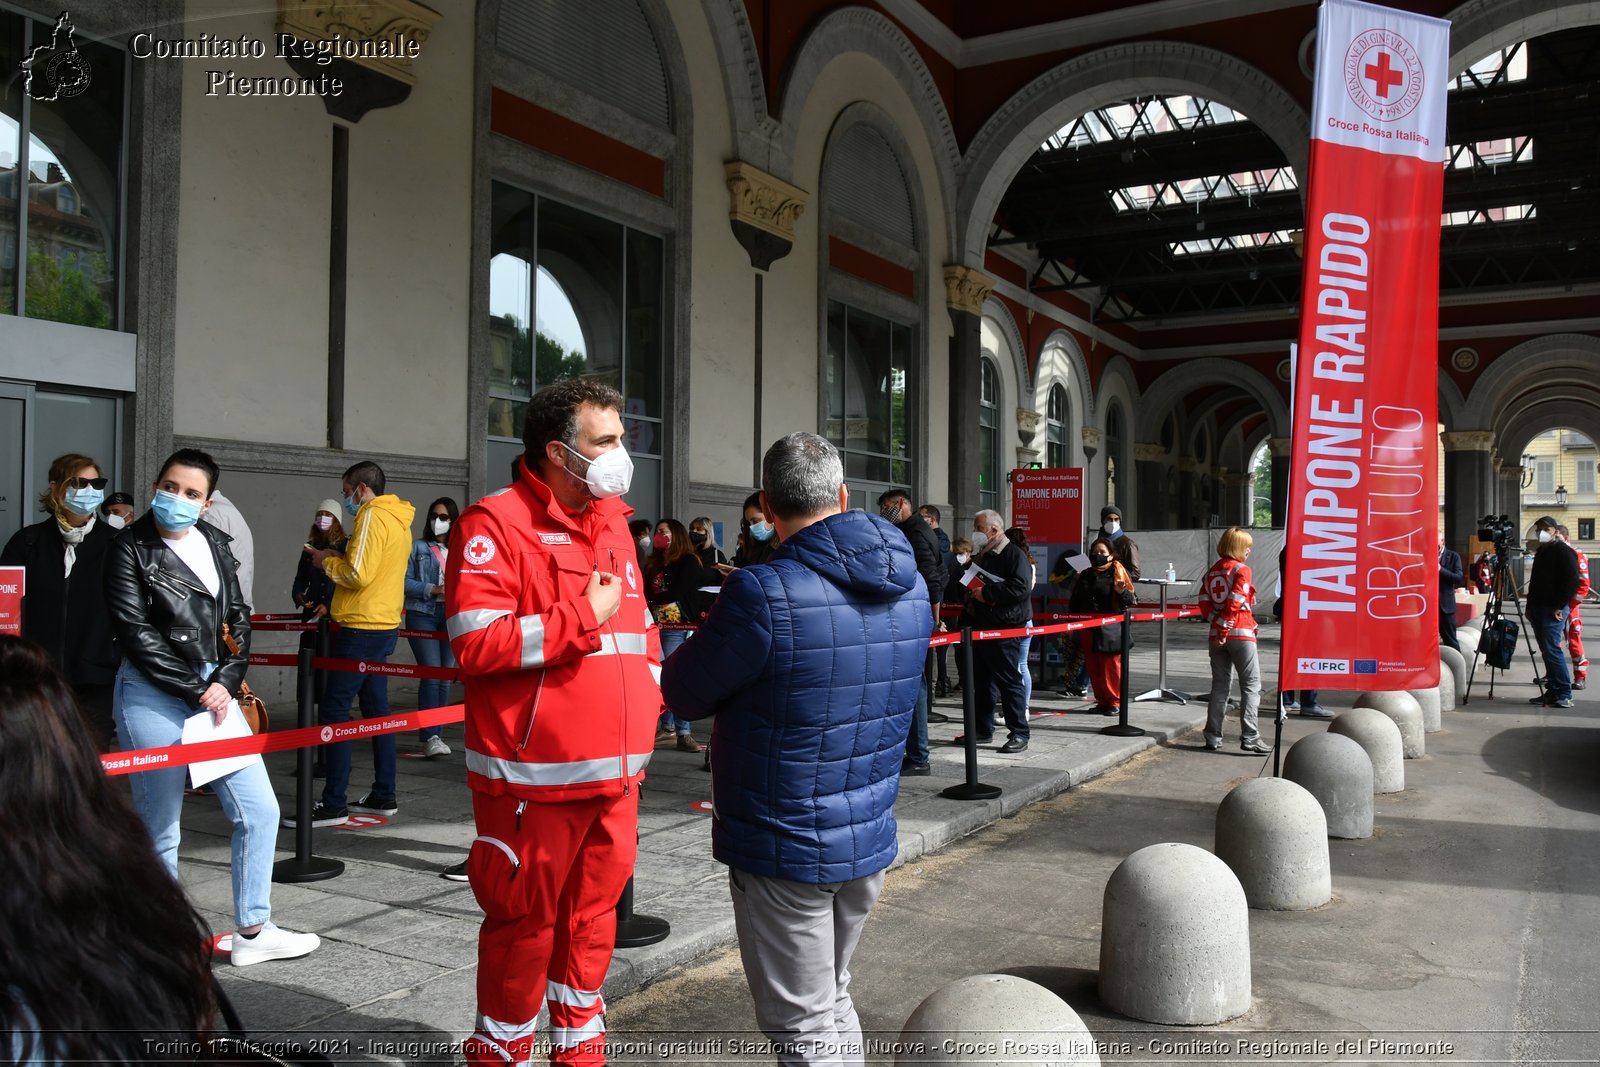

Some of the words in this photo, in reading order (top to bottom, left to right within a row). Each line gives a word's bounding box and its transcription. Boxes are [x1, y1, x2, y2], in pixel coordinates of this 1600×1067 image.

[1358, 37, 1370, 50] DI
[1370, 32, 1408, 56] GINEVRA
[1407, 56, 1417, 67] 22
[1348, 46, 1376, 113] CONVENZIONE
[1404, 69, 1422, 108] AGOSTO
[1386, 101, 1405, 117] 1864
[1328, 117, 1359, 131] Croce
[1362, 123, 1392, 139] Rossa
[1396, 129, 1430, 146] Italiana
[1313, 212, 1370, 383] RAPIDO
[1016, 488, 1050, 498] TAMPONE
[1052, 488, 1079, 498] RAPIDO
[1299, 394, 1363, 619] TAMPONE
[1367, 405, 1427, 619] GRATUITO
[1318, 662, 1345, 671] IFRC
[335, 727, 357, 736] Croce
[359, 723, 381, 733] Rossa
[382, 719, 407, 729] Italiana
[133, 754, 169, 766] Italiana
